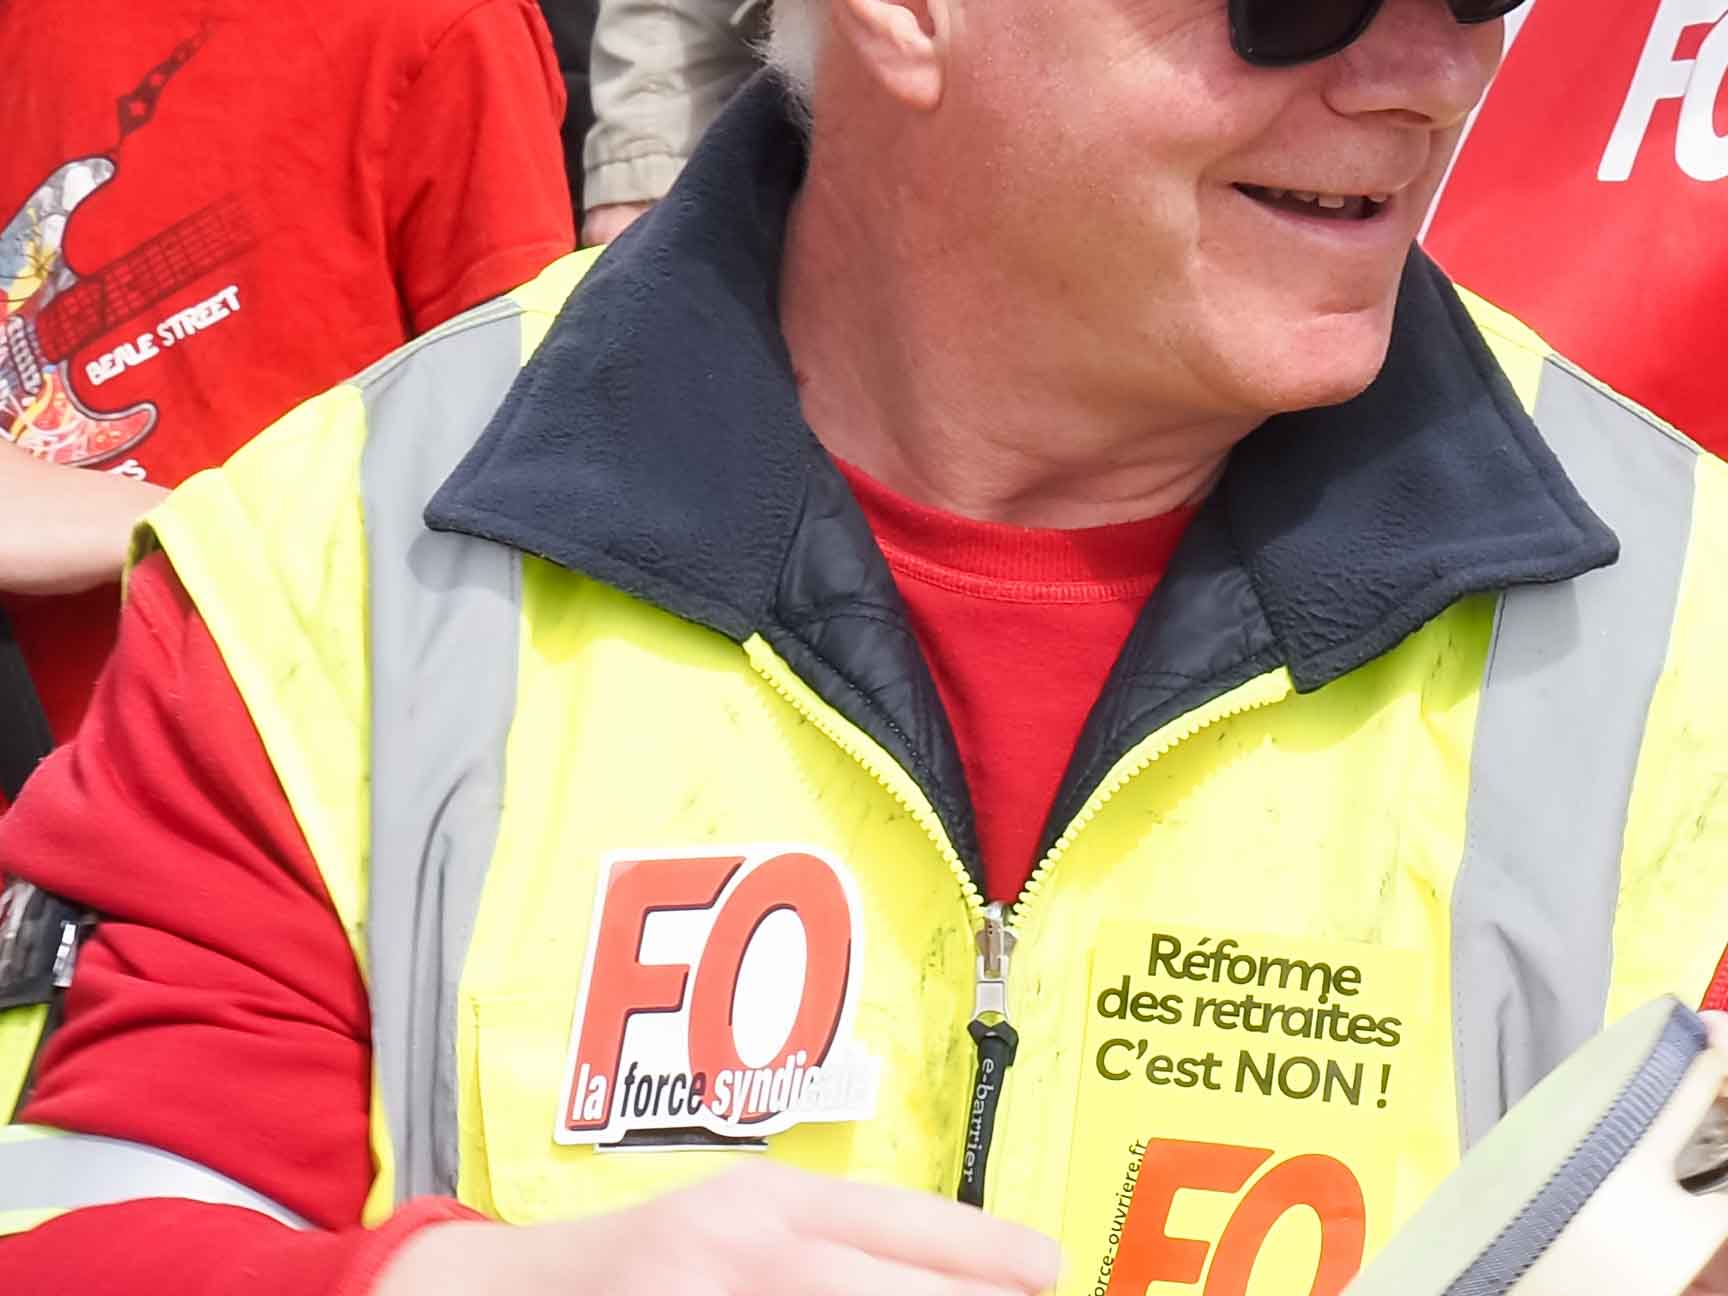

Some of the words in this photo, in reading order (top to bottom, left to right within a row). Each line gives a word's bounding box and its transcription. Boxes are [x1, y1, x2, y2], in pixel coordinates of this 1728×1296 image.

[84, 332, 160, 386] BEALE
[156, 284, 240, 347] STREET
[564, 851, 853, 1131] FO
[1147, 932, 1362, 996] Réforme
[1096, 974, 1184, 1025] des
[1192, 992, 1403, 1047] retraites
[572, 1063, 609, 1121] la
[620, 1061, 707, 1118] force
[1095, 1037, 1223, 1091] C'est
[1234, 1049, 1364, 1106] NON
[963, 1058, 995, 1183] e-barrier
